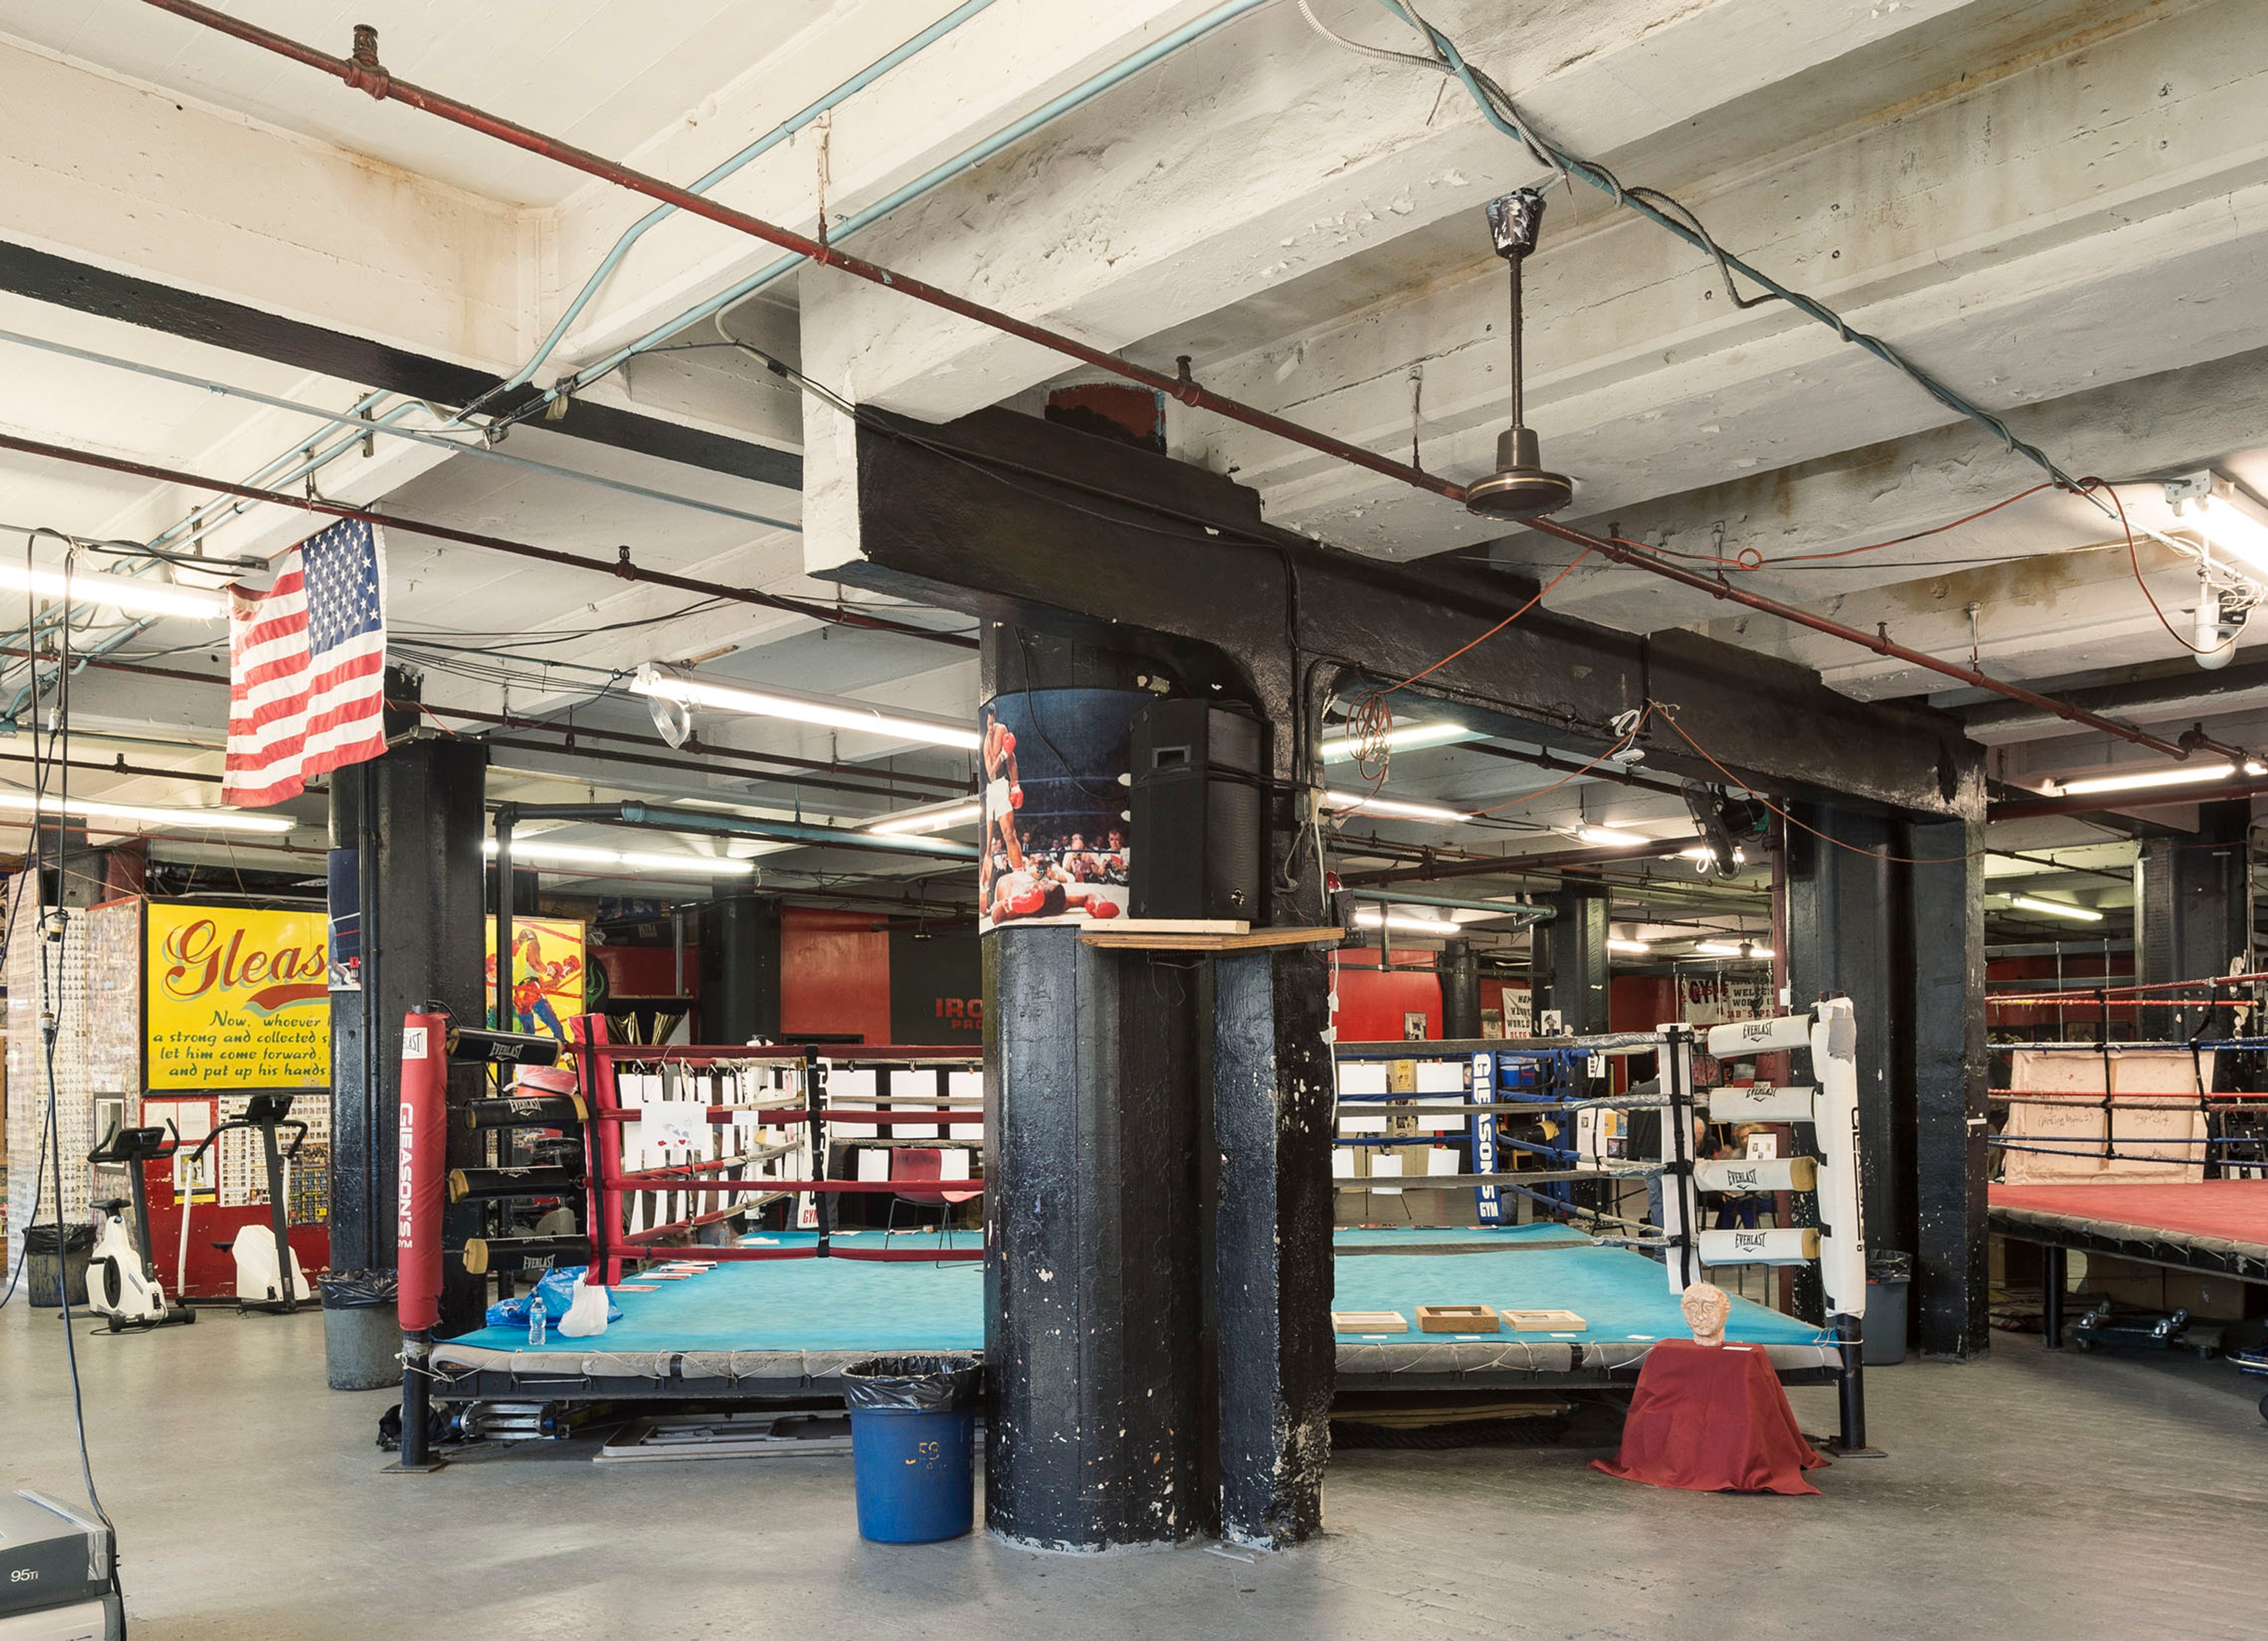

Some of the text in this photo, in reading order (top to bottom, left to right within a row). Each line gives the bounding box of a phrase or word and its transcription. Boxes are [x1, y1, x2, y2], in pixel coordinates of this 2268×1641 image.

[936, 998, 983, 1017] IRO
[209, 1010, 250, 1027] Now,
[263, 1014, 321, 1027] whoever
[1507, 1020, 1530, 1028] WORLD
[153, 1034, 163, 1042] a
[170, 1032, 217, 1046] strong
[223, 1030, 250, 1043] and
[257, 1031, 315, 1043] collected
[1743, 1021, 1774, 1039] EVERLAST
[161, 1046, 321, 1061] let him come forward,
[488, 1041, 524, 1059] EVERLAST
[169, 1063, 197, 1076] and
[204, 1065, 228, 1079] put
[235, 1067, 252, 1079] up
[258, 1063, 278, 1076] his
[508, 1098, 542, 1113] EVERLAST
[1727, 1169, 1757, 1186] EVERLAST
[1480, 1202, 1498, 1218] GYM
[1735, 1232, 1767, 1248] EVERLAST
[523, 1254, 556, 1270] EVERLAST
